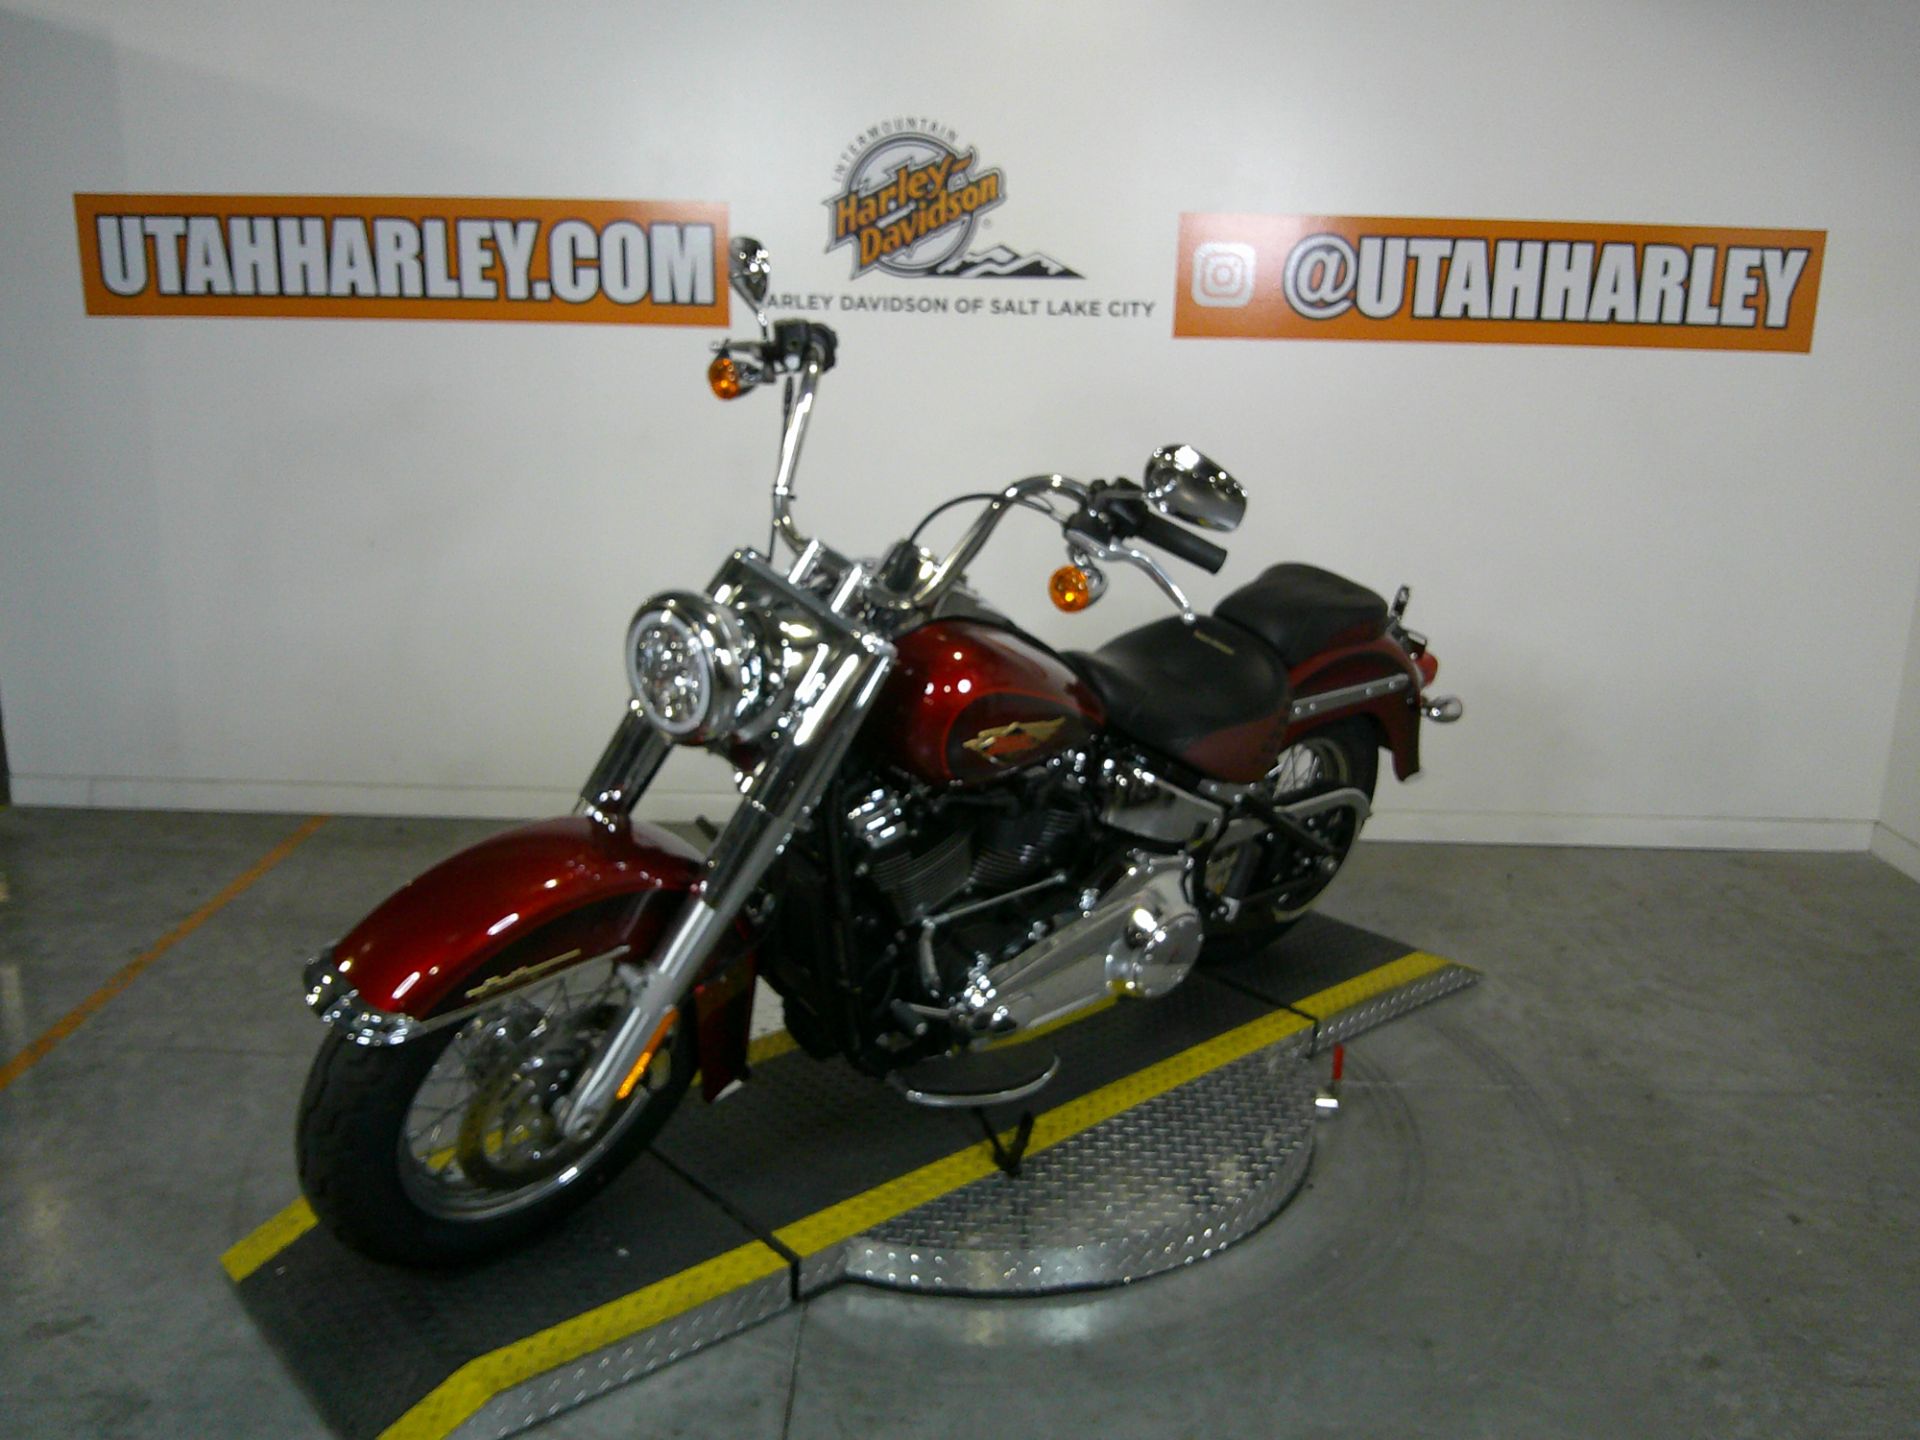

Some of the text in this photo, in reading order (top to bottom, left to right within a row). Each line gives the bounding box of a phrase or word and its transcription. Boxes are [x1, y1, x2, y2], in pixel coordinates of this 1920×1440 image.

[832, 117, 959, 182] INTERMOUNTAIN
[96, 213, 716, 306] UTAHHARLEY.COM
[859, 172, 999, 267] Davidson
[765, 294, 1155, 317] ARLEY DAVIDSON OF SALT LAKE CITY
[1282, 232, 1812, 330] @UTAHHARLEY
